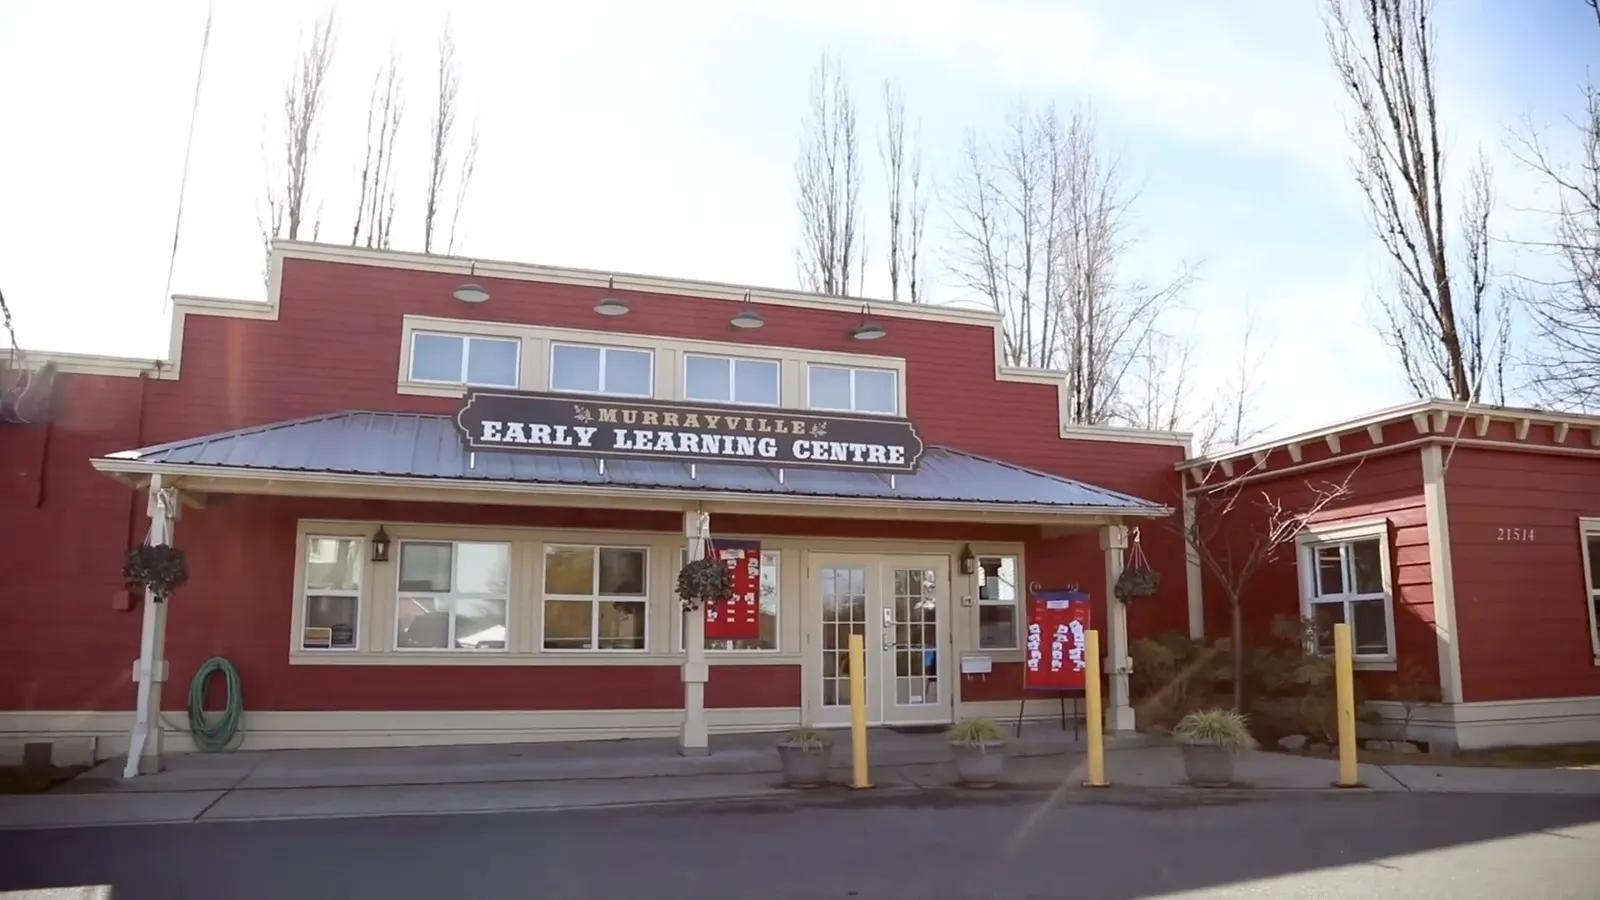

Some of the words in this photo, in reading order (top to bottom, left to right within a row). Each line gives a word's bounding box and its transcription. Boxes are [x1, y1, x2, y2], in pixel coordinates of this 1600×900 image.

[598, 409, 807, 435] MURRAYVILLE
[480, 420, 598, 448] EARLY
[612, 429, 778, 459] LEARNING
[791, 439, 906, 466] CENTRE
[1497, 528, 1534, 541] 21514
